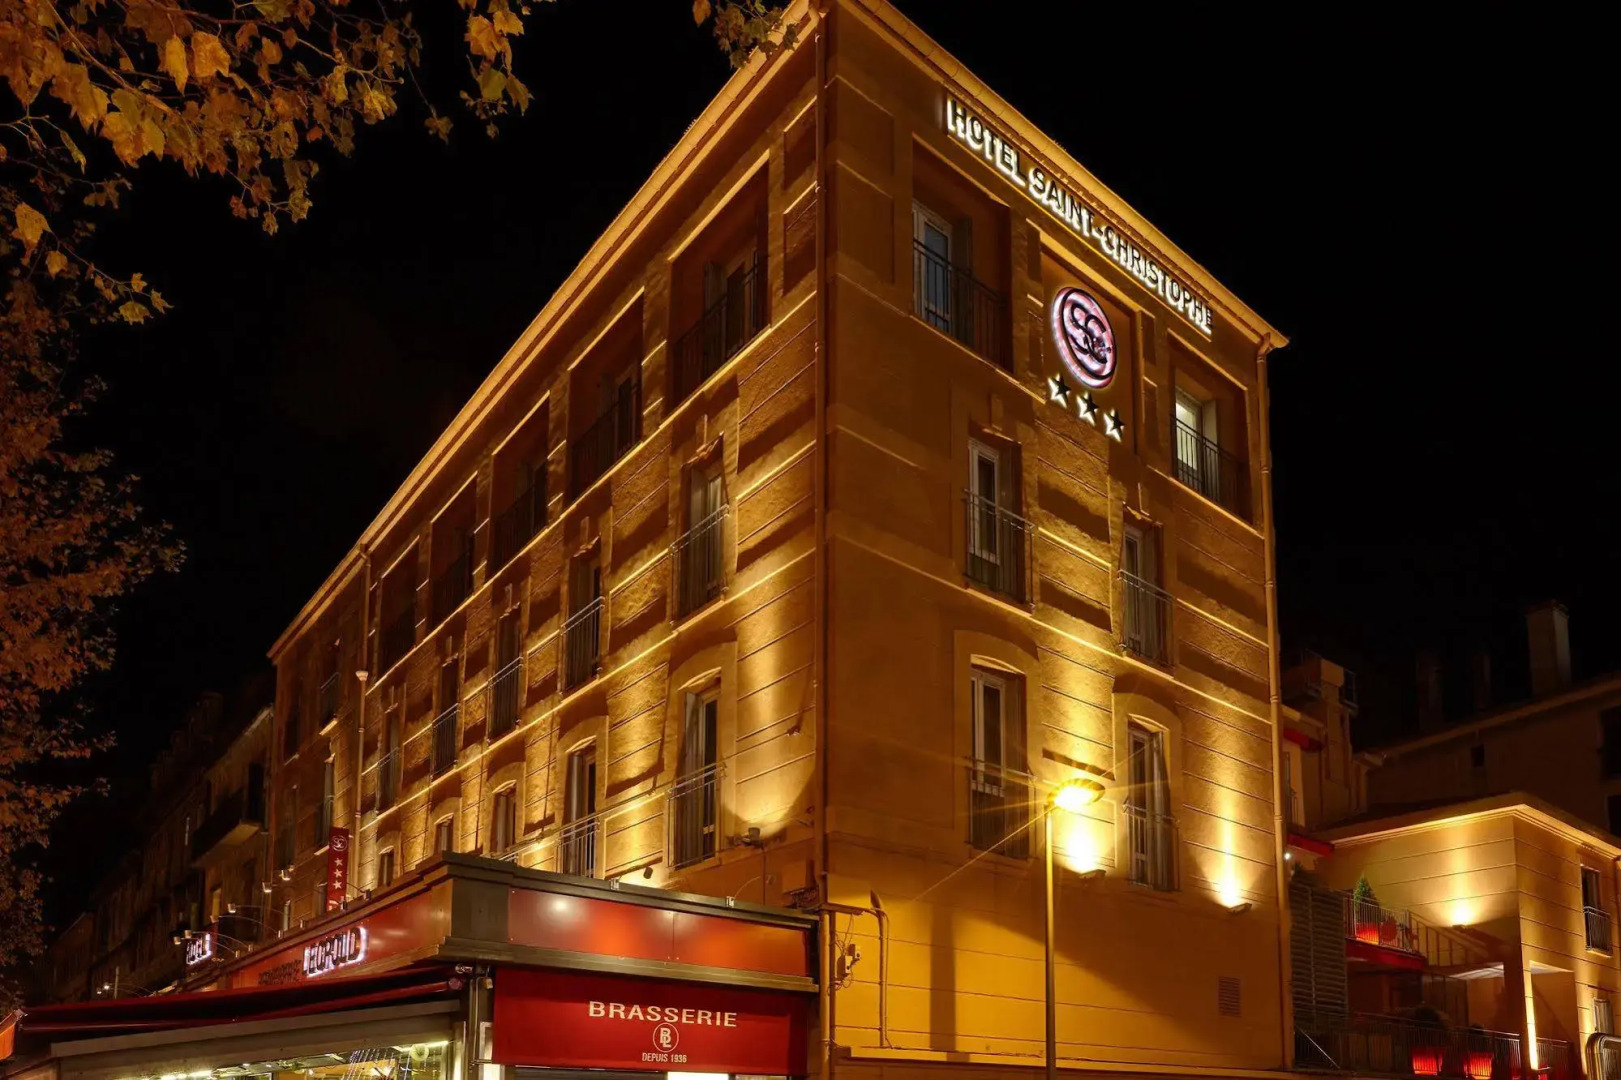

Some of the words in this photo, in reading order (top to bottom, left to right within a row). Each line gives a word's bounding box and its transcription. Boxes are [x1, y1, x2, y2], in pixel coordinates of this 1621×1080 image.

[947, 98, 1027, 187] HOTEL
[1028, 167, 1213, 335] SAINT-CHRISTOPHE
[588, 1001, 737, 1027] BRASSERIE
[642, 1052, 668, 1063] DEPUIS
[671, 1053, 687, 1063] 1936
